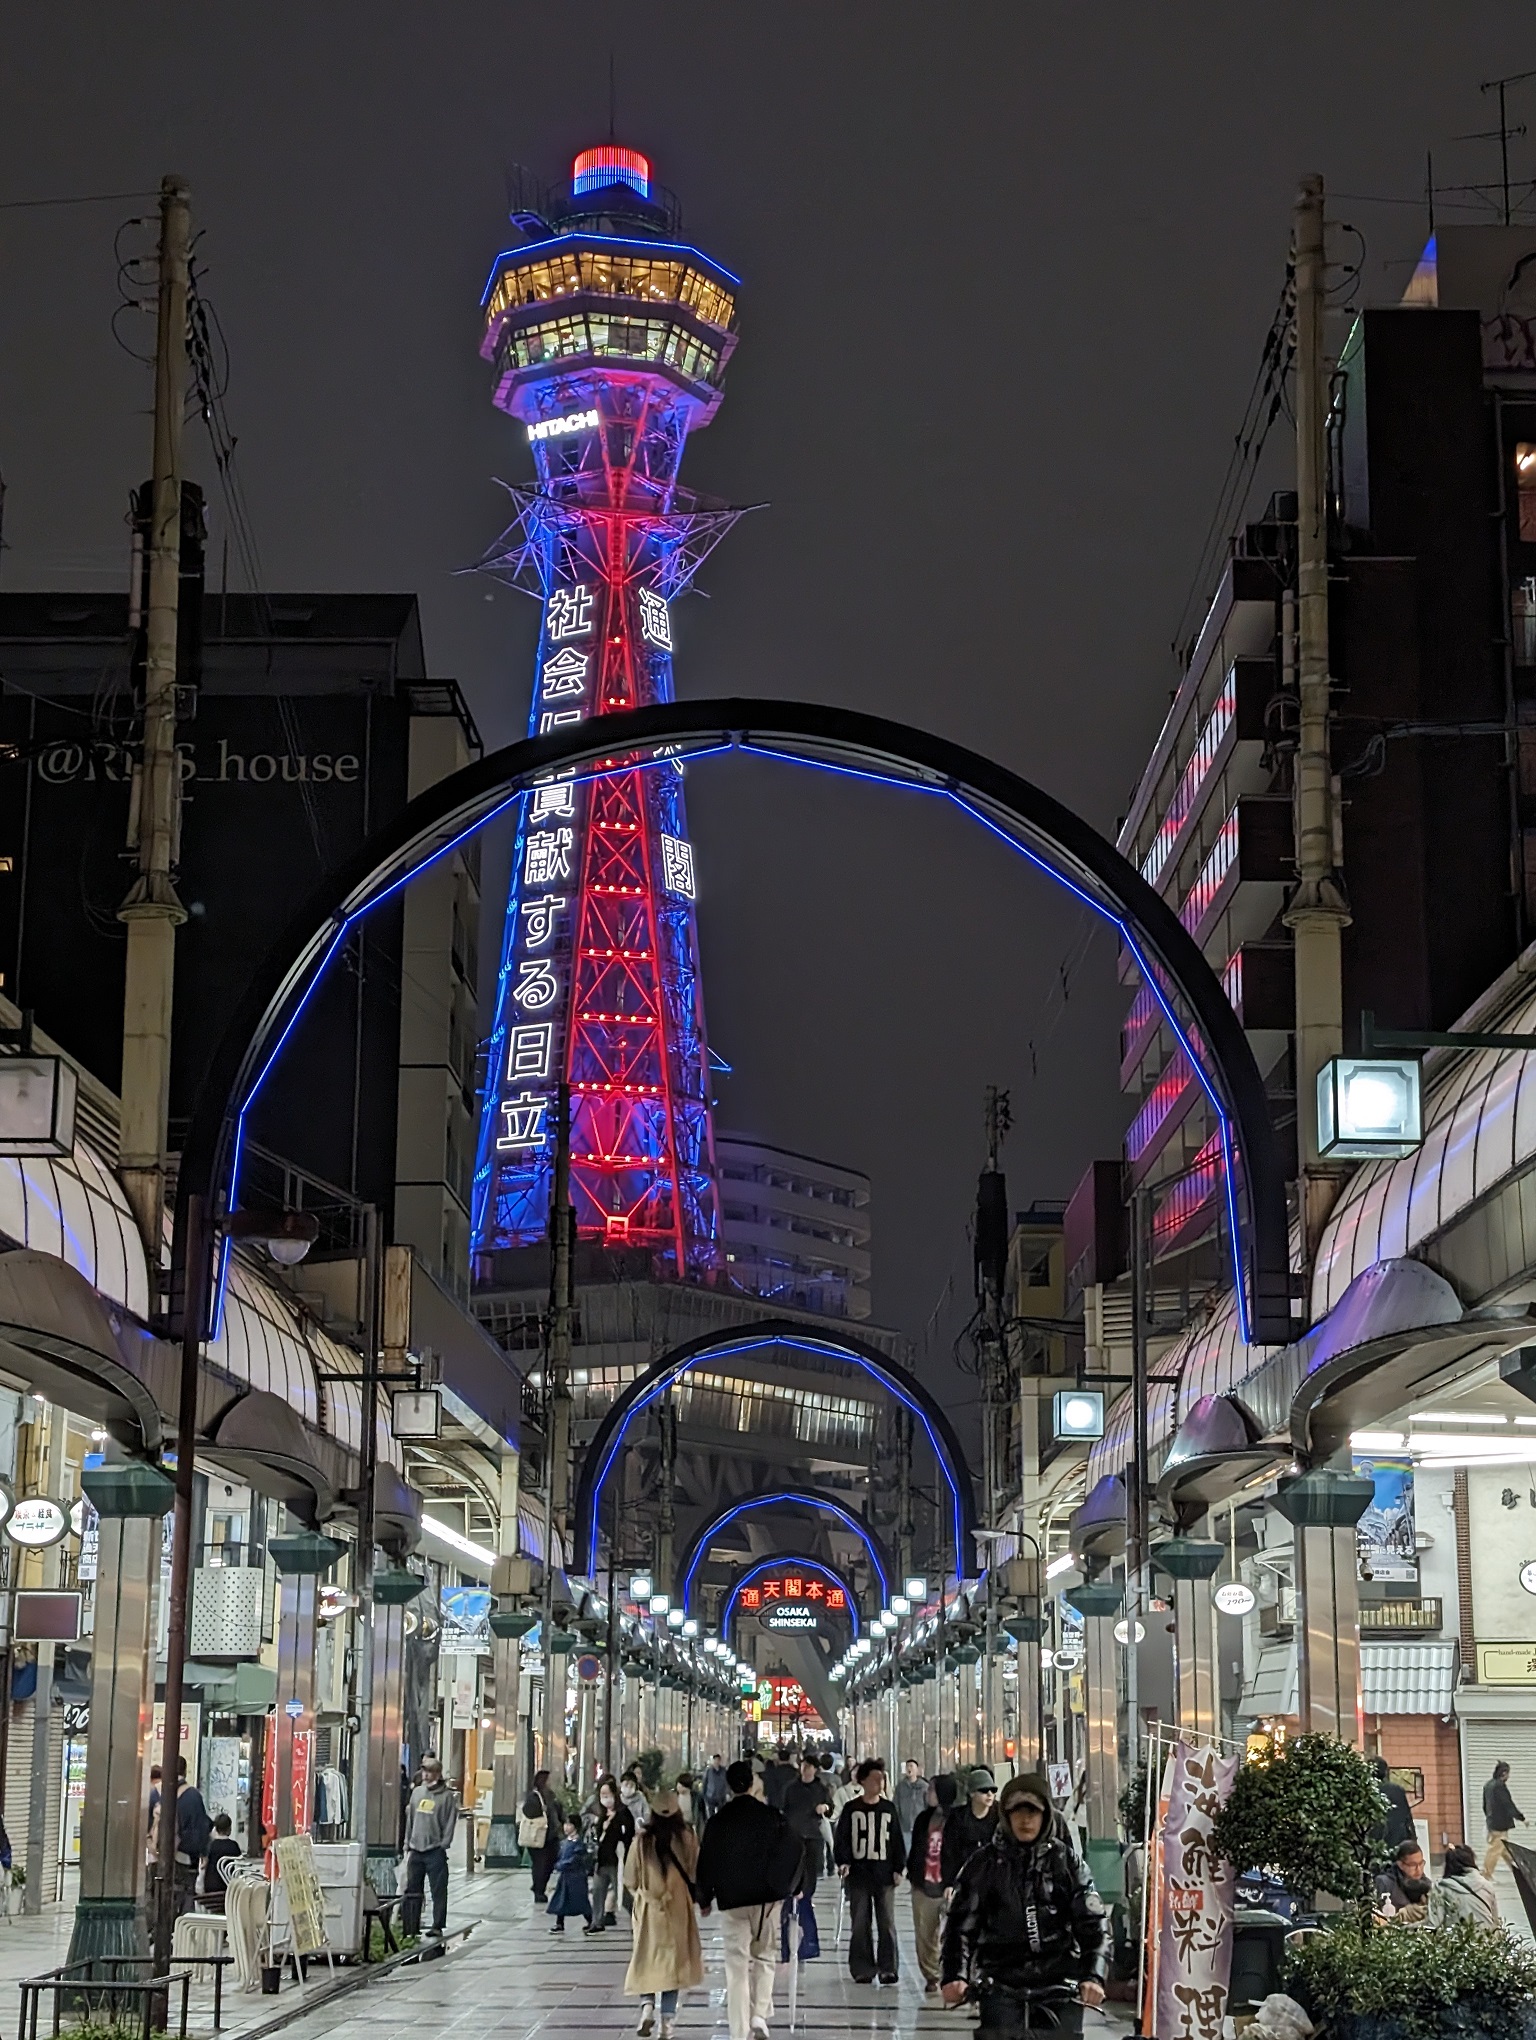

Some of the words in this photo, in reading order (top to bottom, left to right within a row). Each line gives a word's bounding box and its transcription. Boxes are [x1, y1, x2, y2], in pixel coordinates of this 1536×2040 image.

[527, 409, 599, 441] HITACHI
[742, 1578, 844, 1607] 通天閣本通
[776, 1607, 810, 1617] OSAKA
[769, 1617, 817, 1628] SHINSEKAI
